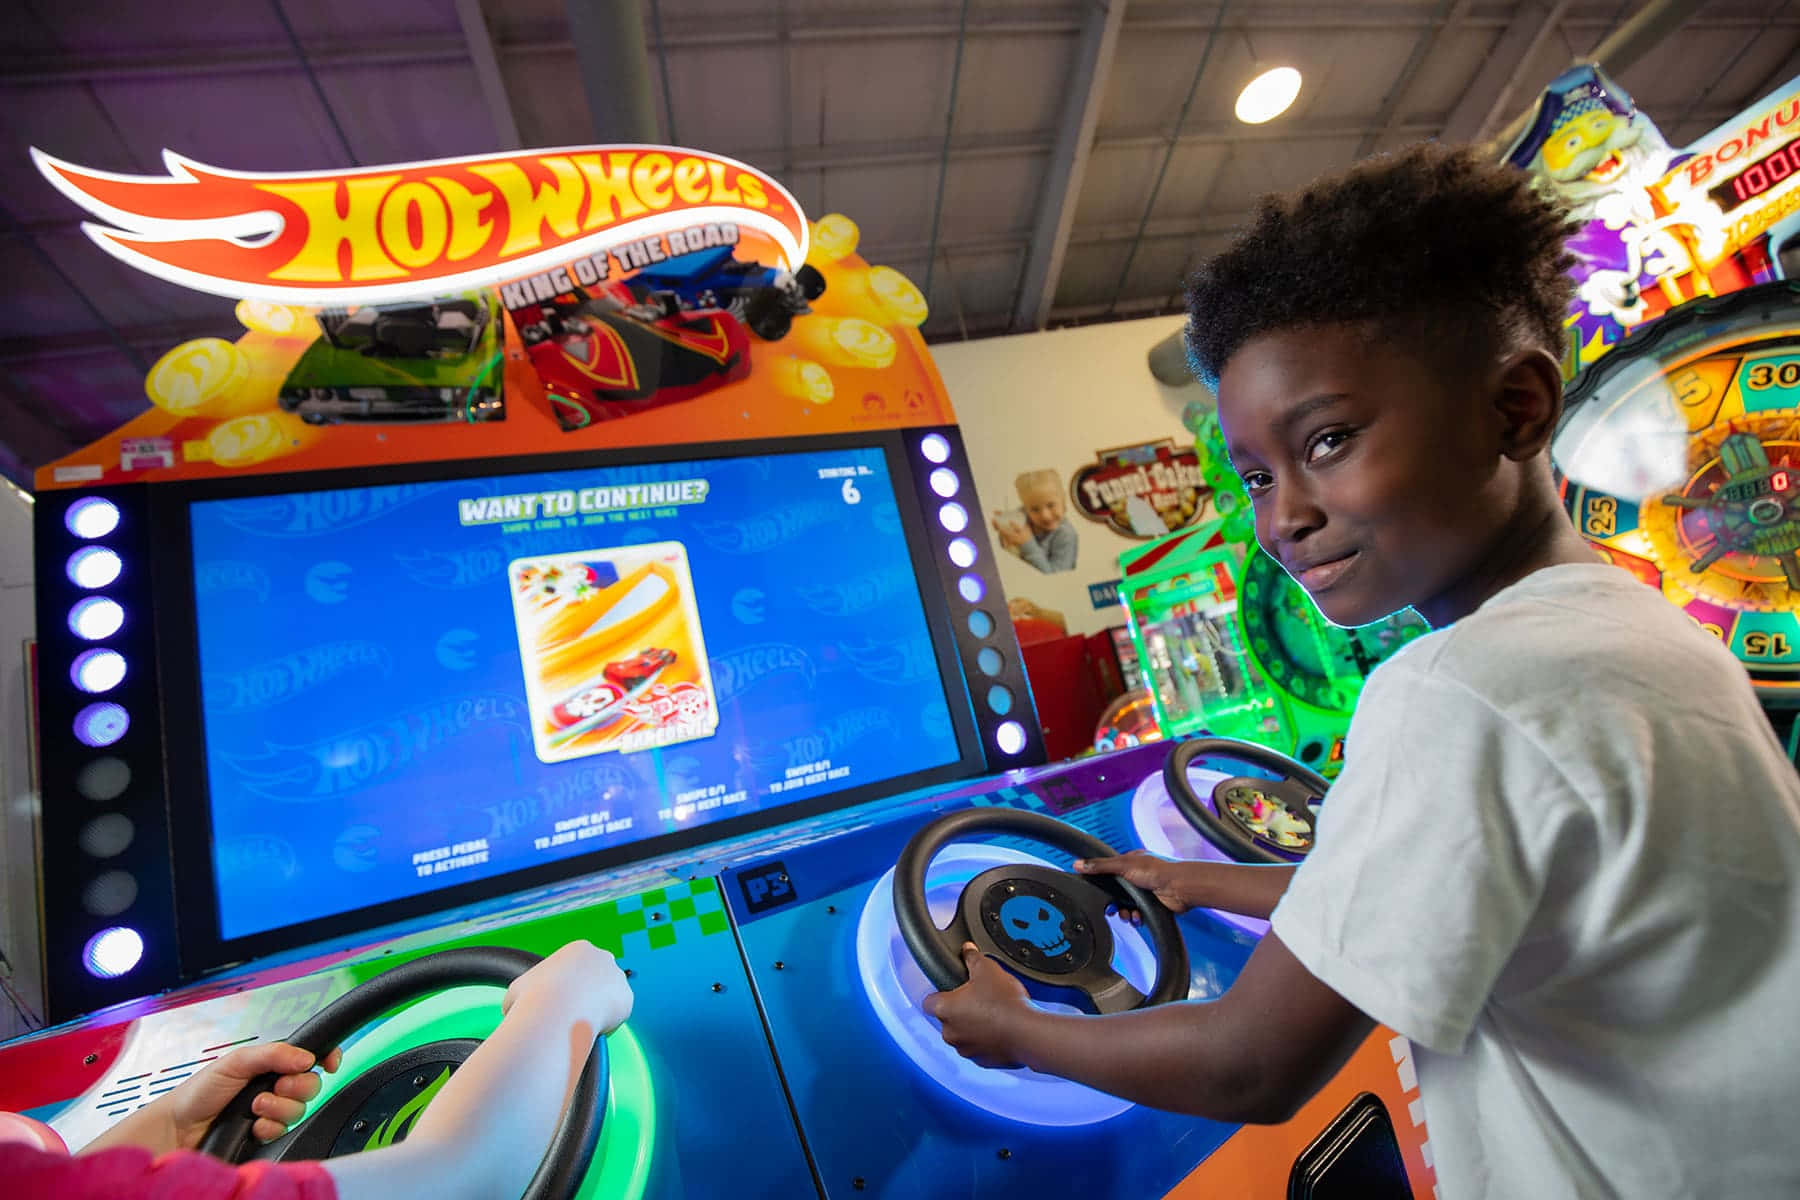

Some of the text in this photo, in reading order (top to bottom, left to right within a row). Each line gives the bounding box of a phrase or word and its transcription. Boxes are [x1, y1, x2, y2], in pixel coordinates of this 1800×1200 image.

[252, 174, 494, 282] HOT
[501, 222, 739, 311] KING OF THE ROAD
[1749, 361, 1800, 390] 30
[459, 494, 537, 525] WANT
[541, 490, 575, 516] TO
[579, 479, 709, 514] CONTINUE?
[842, 478, 861, 504] 6
[1585, 495, 1617, 536] 25
[1744, 630, 1792, 657] 15
[769, 766, 850, 794] TO JOIN NEXT RACE
[785, 765, 814, 779] SWIPE
[697, 796, 721, 812] NEXT
[722, 790, 747, 806] RACE
[534, 817, 633, 850] TO JOIN NEXT RACE
[555, 814, 589, 832] SWIPE
[412, 838, 489, 865] PRESS PEDAL
[416, 850, 489, 878] TO ACTIVATE
[745, 871, 789, 904] P3
